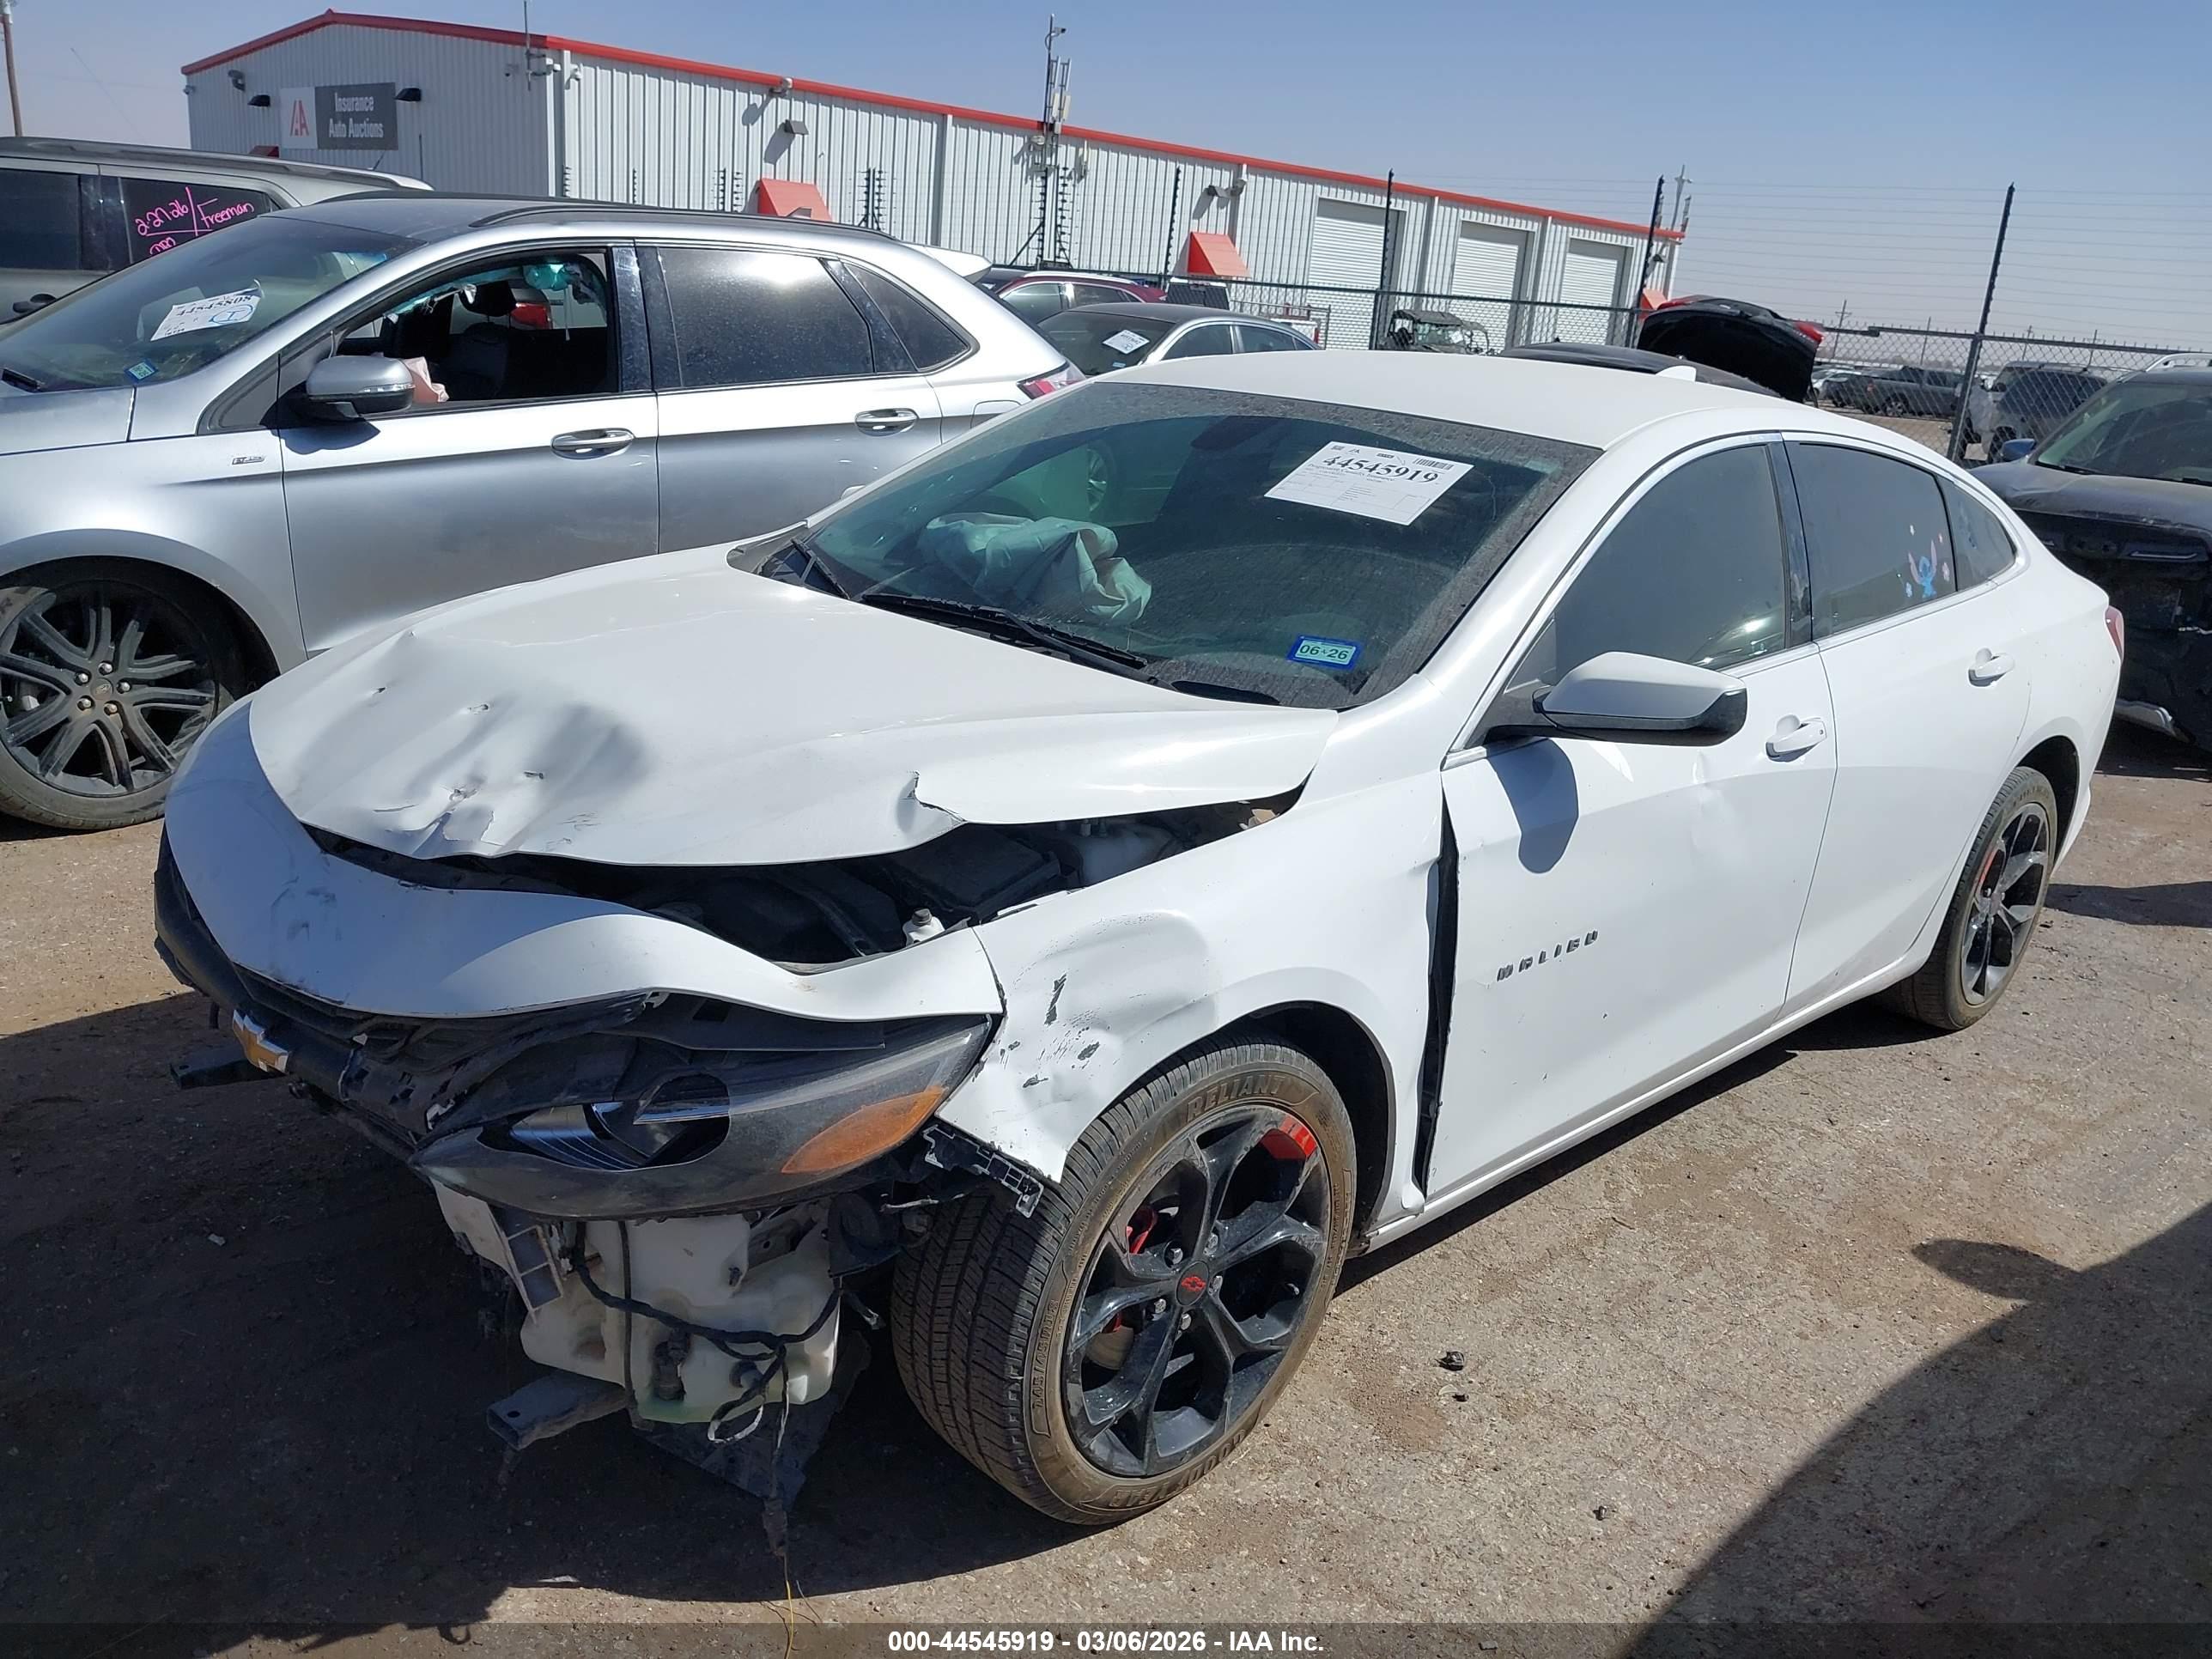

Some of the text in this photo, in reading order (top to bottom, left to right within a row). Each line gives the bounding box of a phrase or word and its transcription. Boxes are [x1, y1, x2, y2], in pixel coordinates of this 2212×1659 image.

[334, 92, 374, 112] Insurance
[329, 117, 384, 138] Auto Auctions
[197, 198, 255, 229] Freeman
[1322, 455, 1439, 483] 44545919
[1497, 929, 1599, 981] MALIBU
